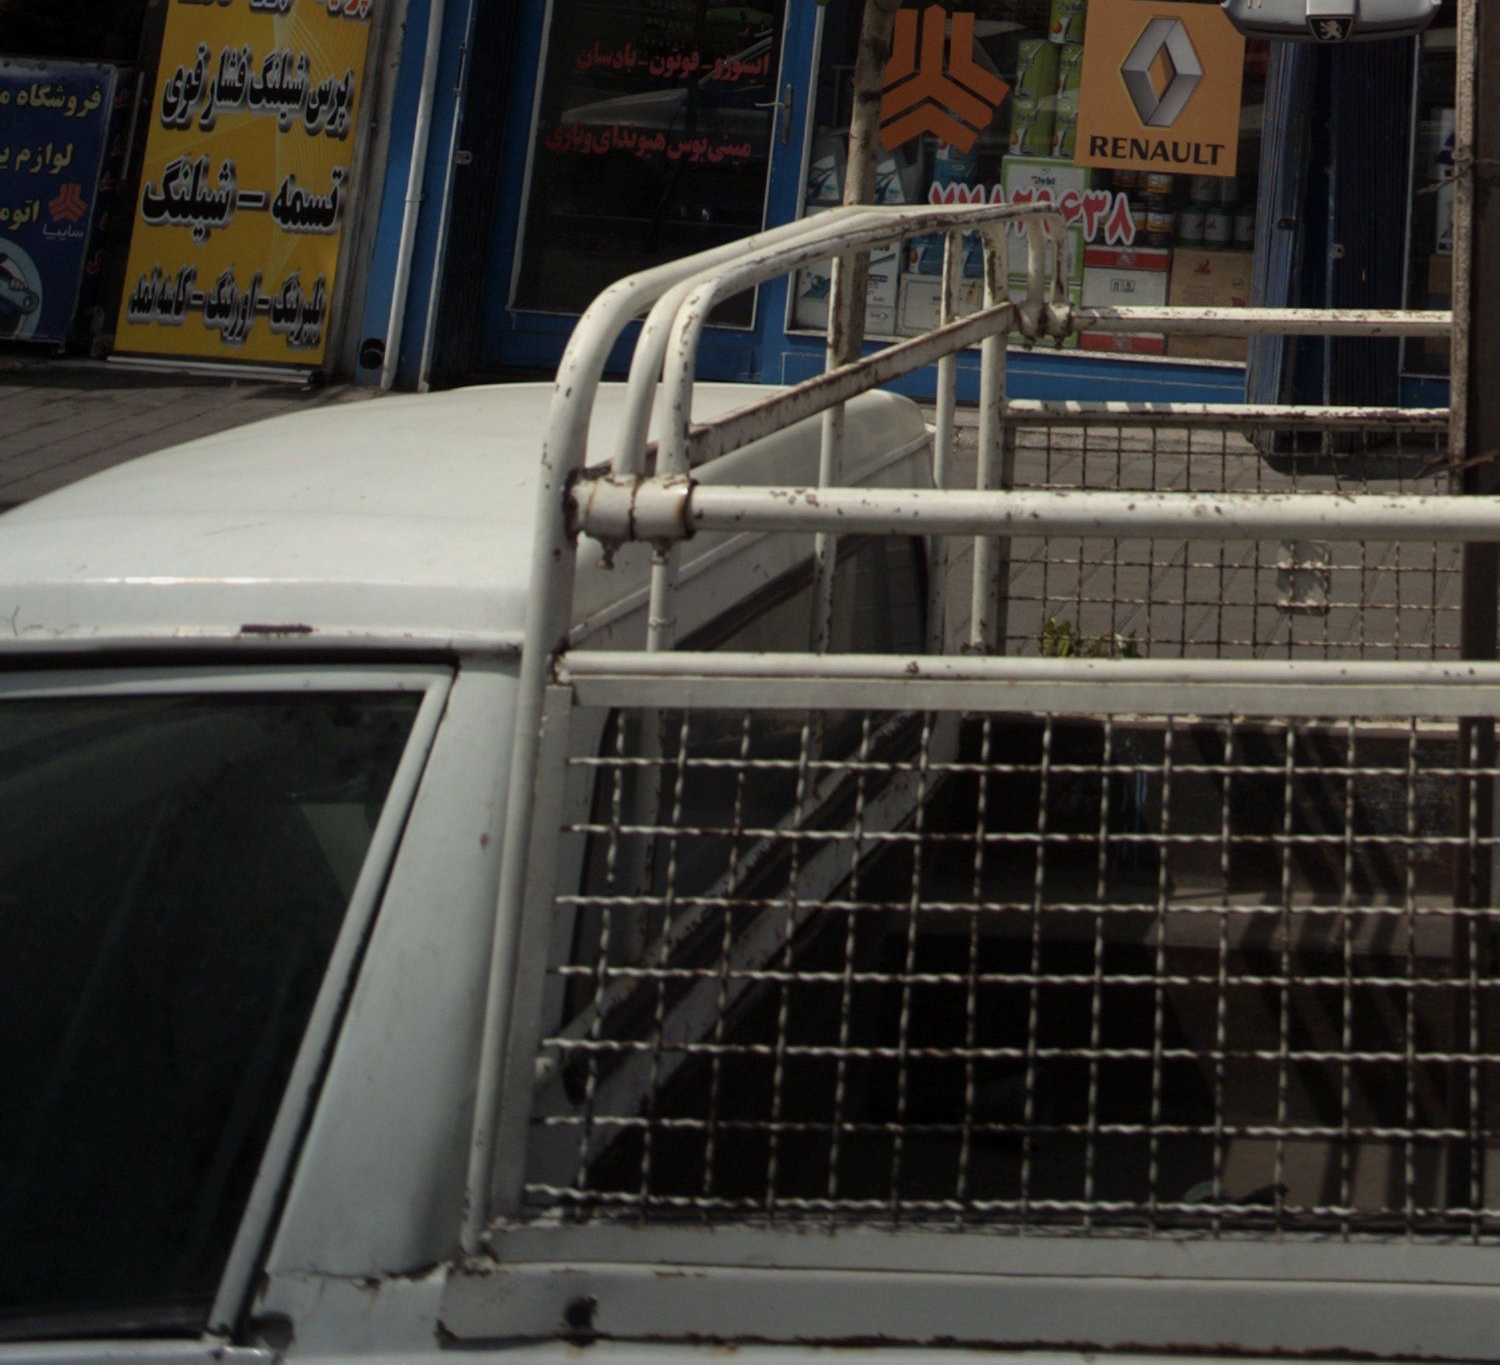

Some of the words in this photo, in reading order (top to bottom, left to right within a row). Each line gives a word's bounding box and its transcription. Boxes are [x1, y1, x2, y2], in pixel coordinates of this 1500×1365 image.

[15, 81, 103, 118] فروشگاه
[160, 44, 207, 127] قوی
[201, 46, 250, 129] فشار
[248, 50, 307, 128] شیلنگ
[305, 68, 355, 135] پرس
[15, 141, 75, 175] لوازم
[1088, 134, 1225, 166] RENAULT
[140, 152, 237, 245] شیلنگ
[270, 165, 348, 235] تسمه
